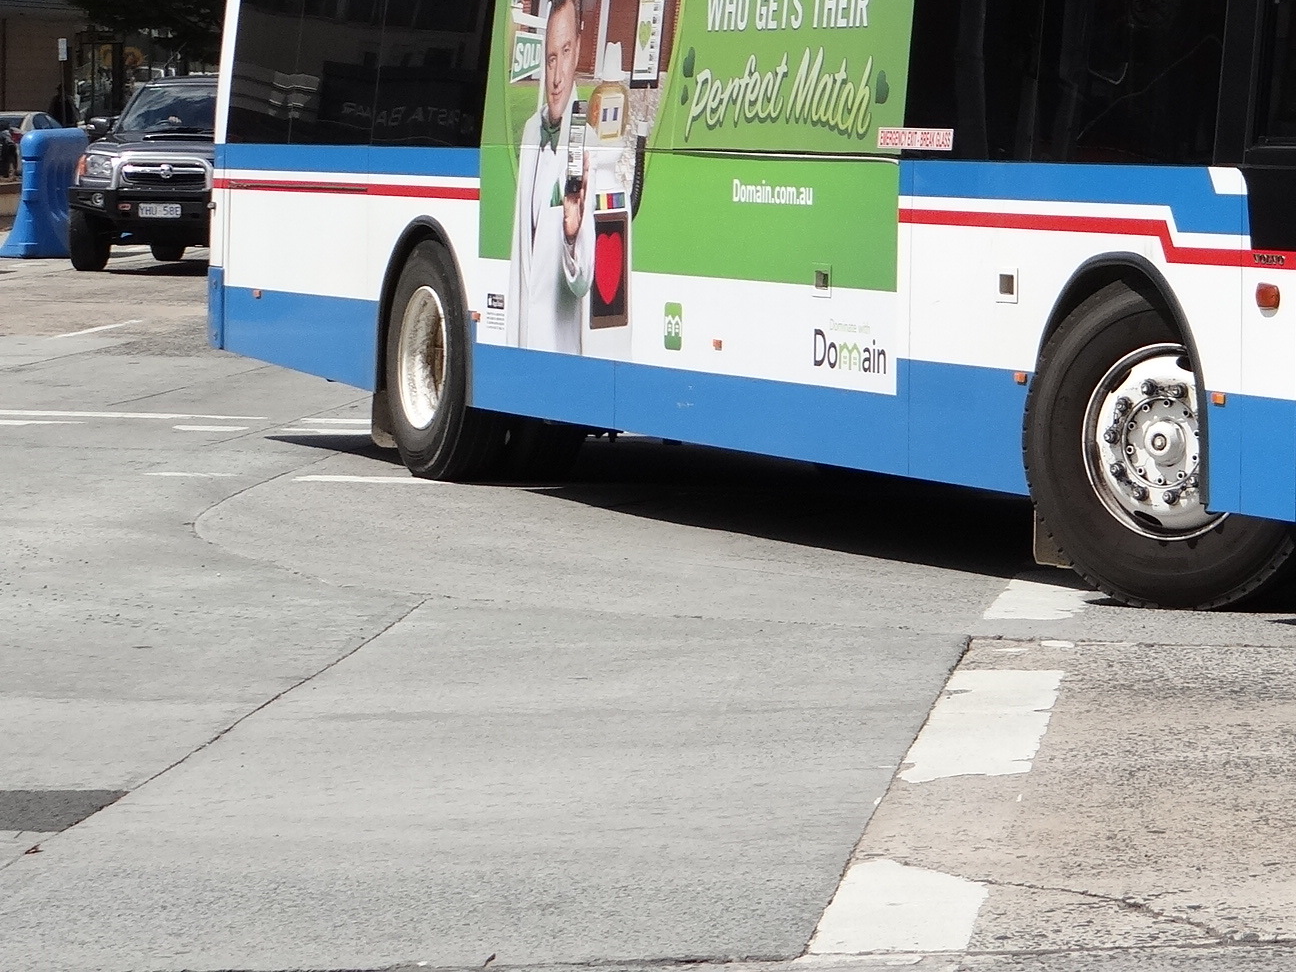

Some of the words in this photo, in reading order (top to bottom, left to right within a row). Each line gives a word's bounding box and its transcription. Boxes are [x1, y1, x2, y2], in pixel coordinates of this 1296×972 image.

[684, 51, 788, 142] Perfect
[786, 45, 874, 137] Match
[732, 178, 814, 206] Domain.com.au
[813, 328, 887, 375] Domain
